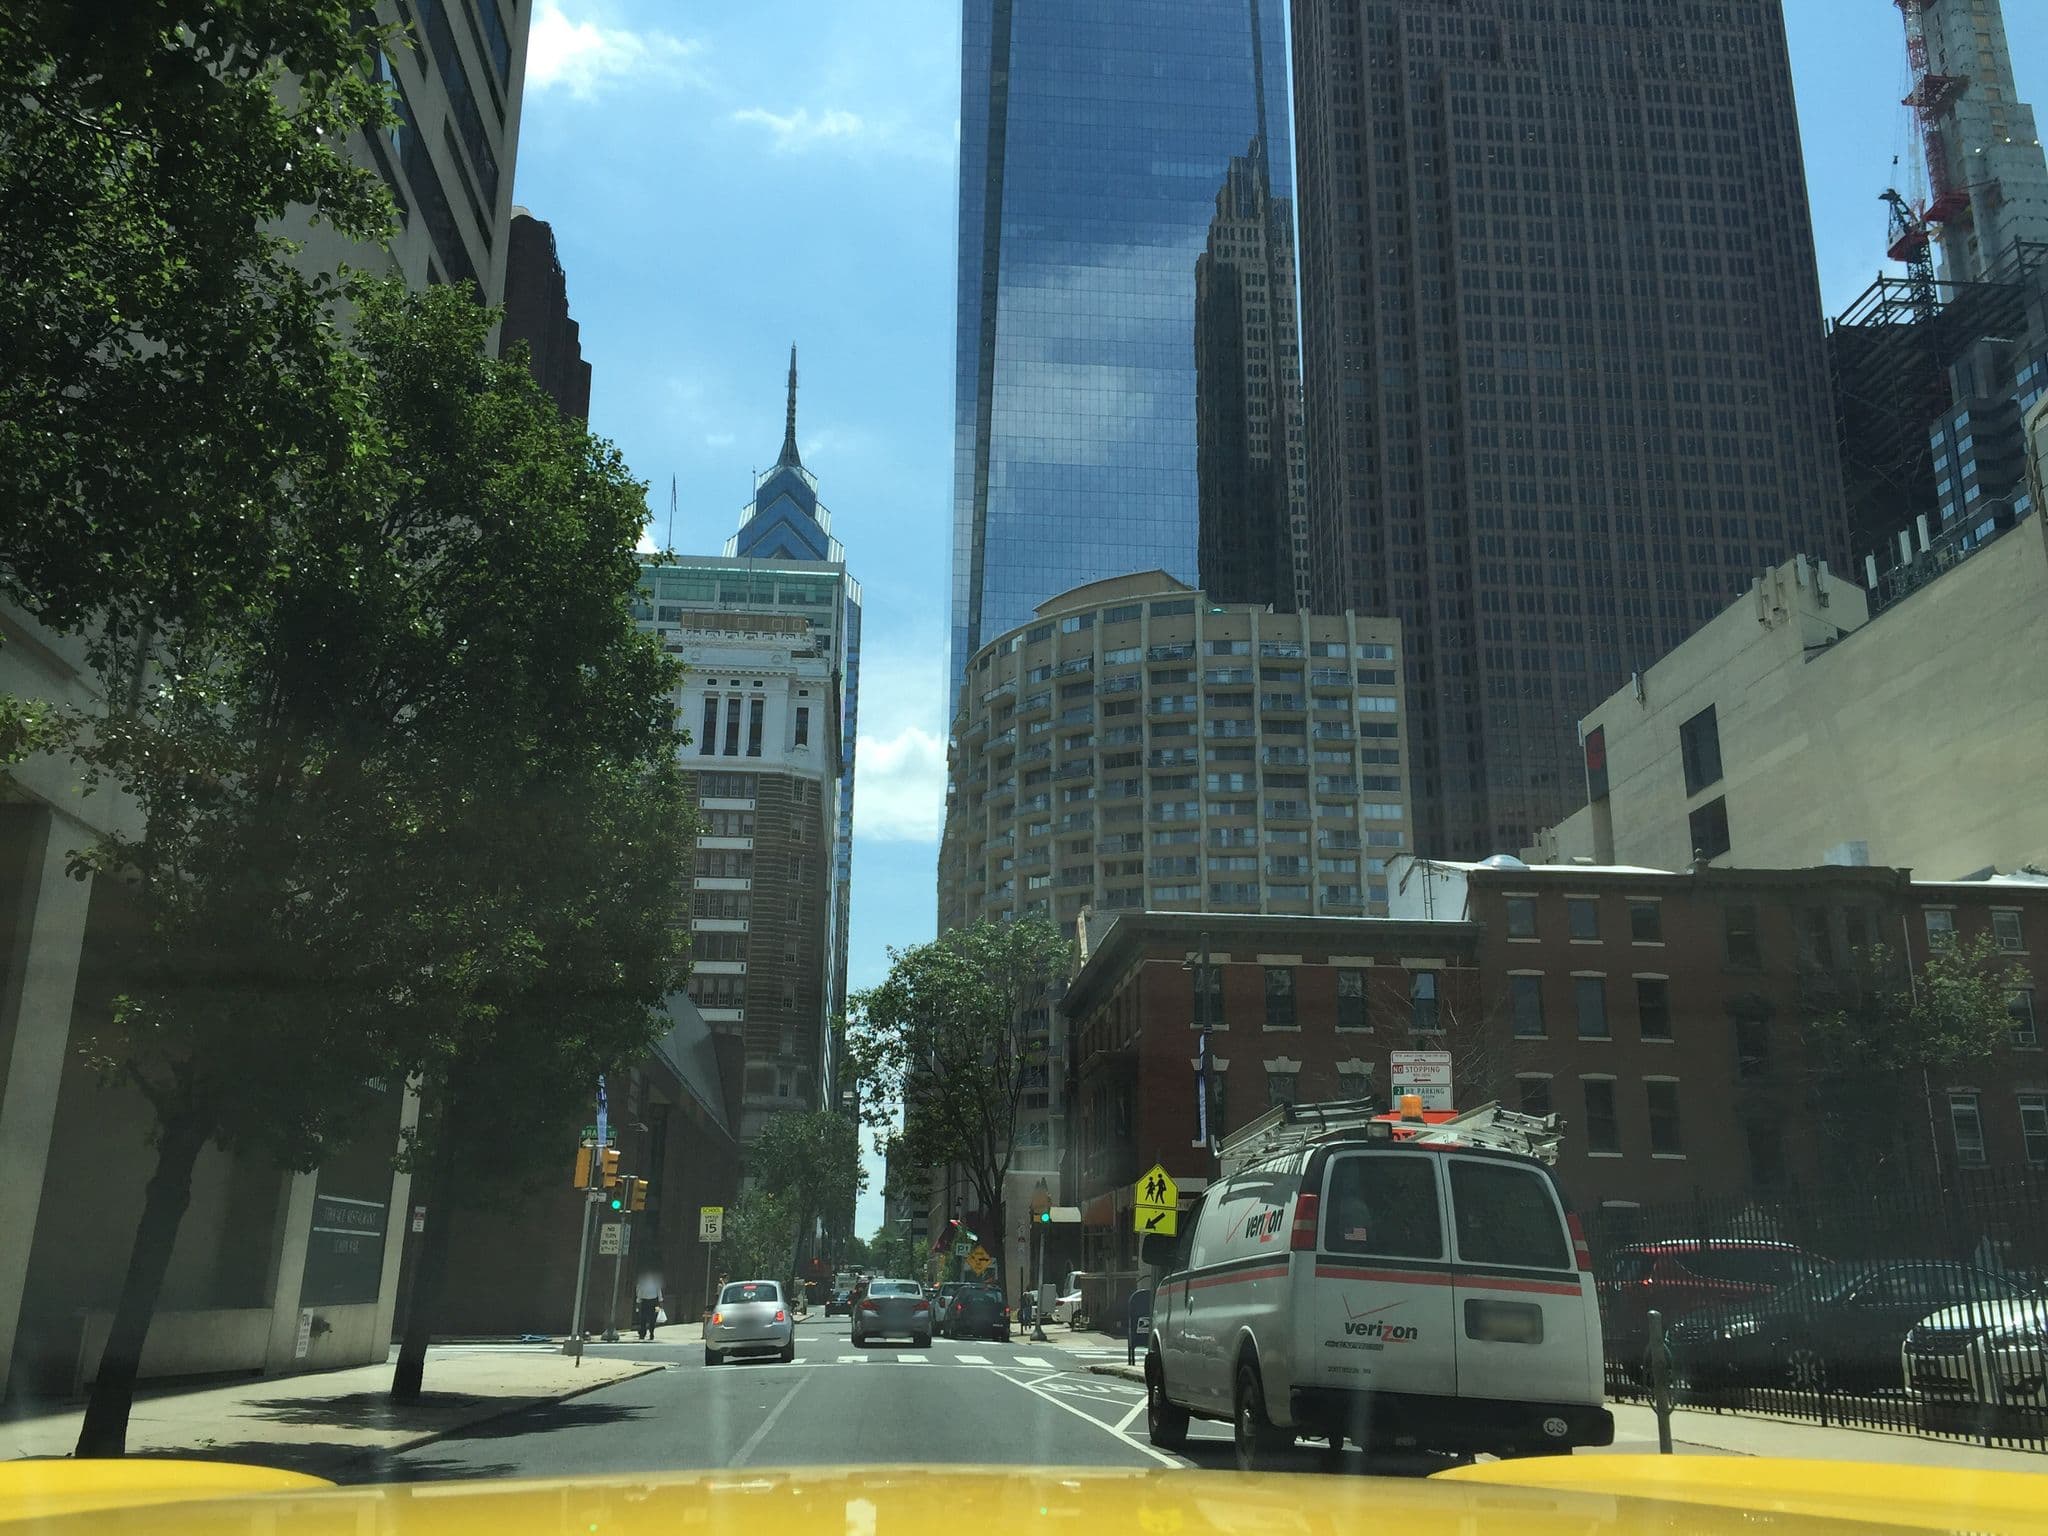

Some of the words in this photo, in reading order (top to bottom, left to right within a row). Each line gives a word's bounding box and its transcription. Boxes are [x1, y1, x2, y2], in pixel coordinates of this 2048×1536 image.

[1393, 1066, 1403, 1074] NO
[1417, 1087, 1445, 1095] PARKING
[705, 1223, 717, 1234] 15
[1245, 1204, 1285, 1243] verizon
[1344, 1320, 1418, 1344] verizon
